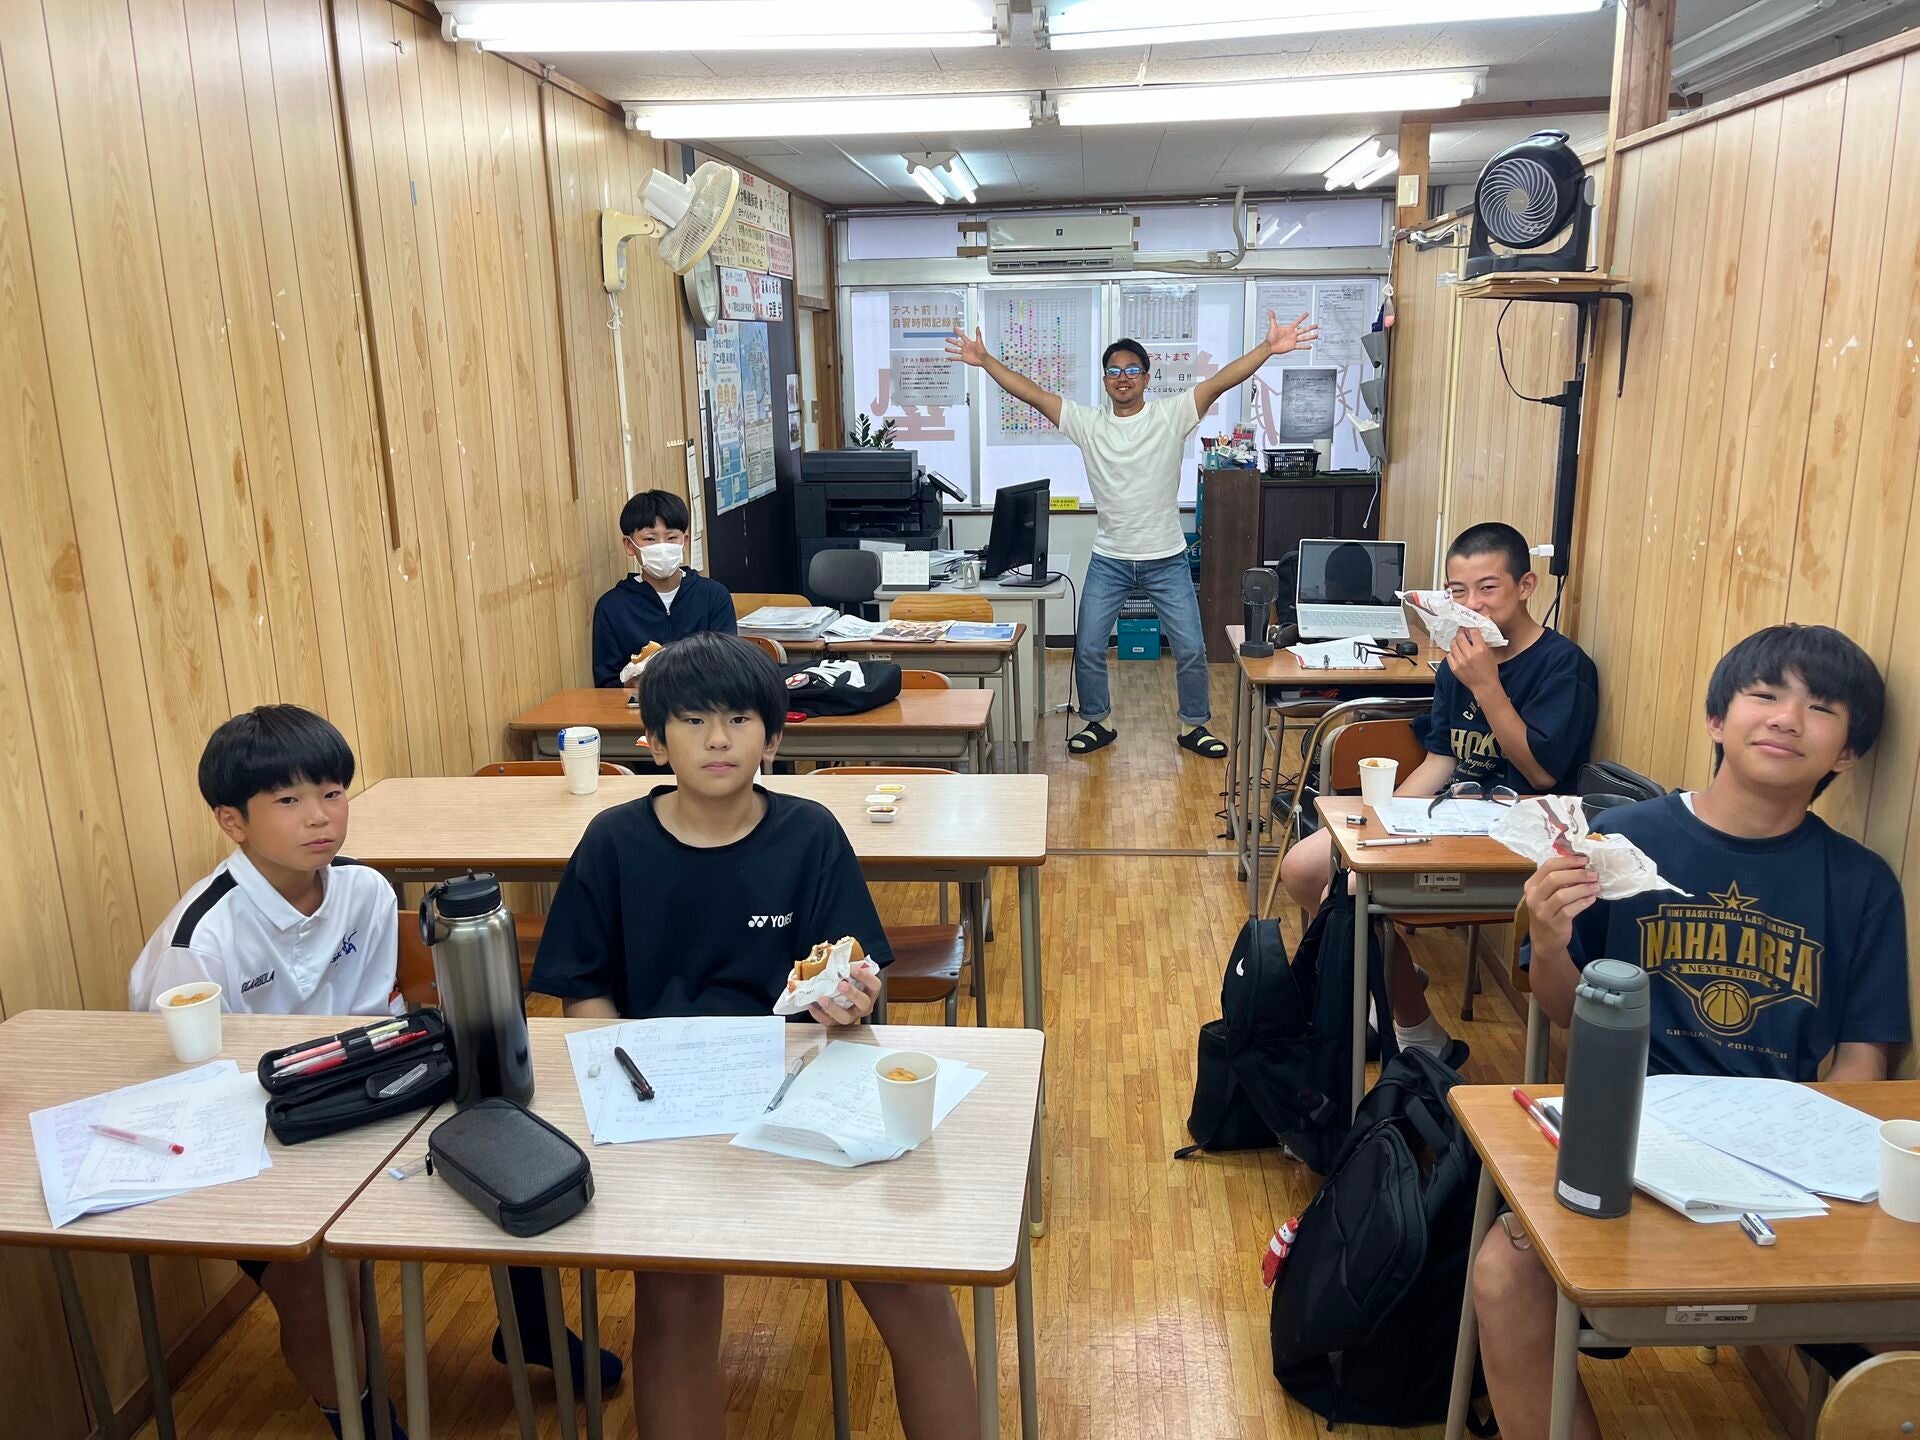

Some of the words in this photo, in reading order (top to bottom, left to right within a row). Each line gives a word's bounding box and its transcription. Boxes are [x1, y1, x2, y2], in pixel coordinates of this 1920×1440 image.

[1154, 368, 1162, 381] 4
[1685, 910, 1743, 922] BASKETBALL
[1646, 919, 1728, 968] NAHA
[1736, 926, 1814, 997] AREA
[1688, 964, 1720, 974] NEXT
